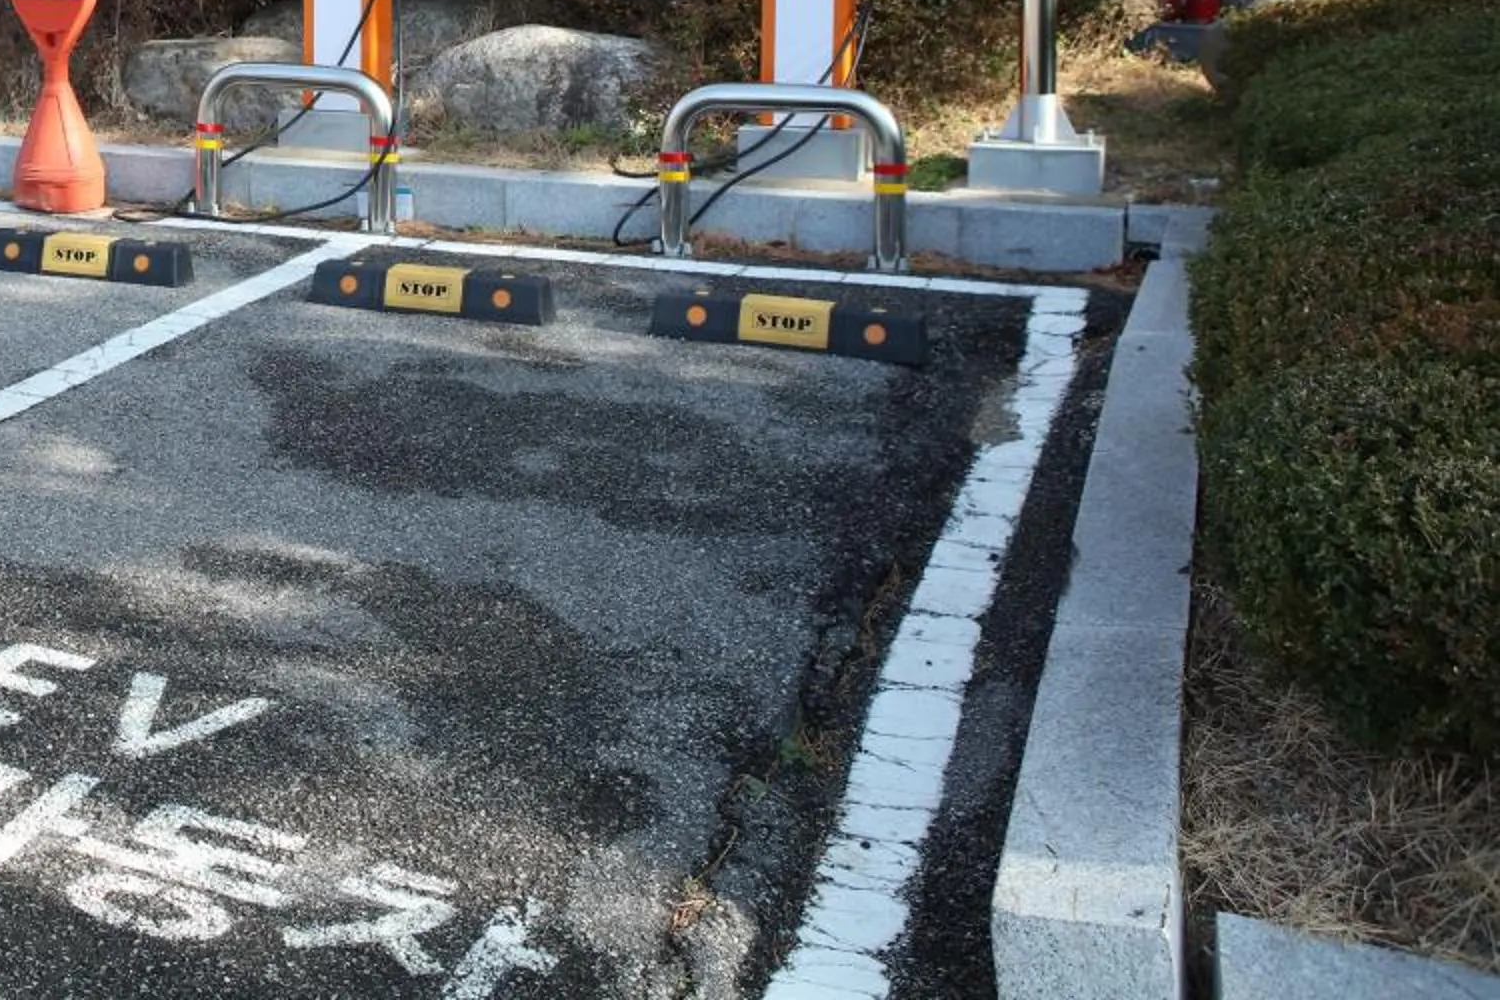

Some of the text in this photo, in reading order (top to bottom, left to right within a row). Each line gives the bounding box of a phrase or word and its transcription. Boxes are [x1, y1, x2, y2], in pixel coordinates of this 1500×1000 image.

[54, 249, 96, 263] STOP
[400, 282, 448, 298] STOP
[756, 313, 813, 331] STOP
